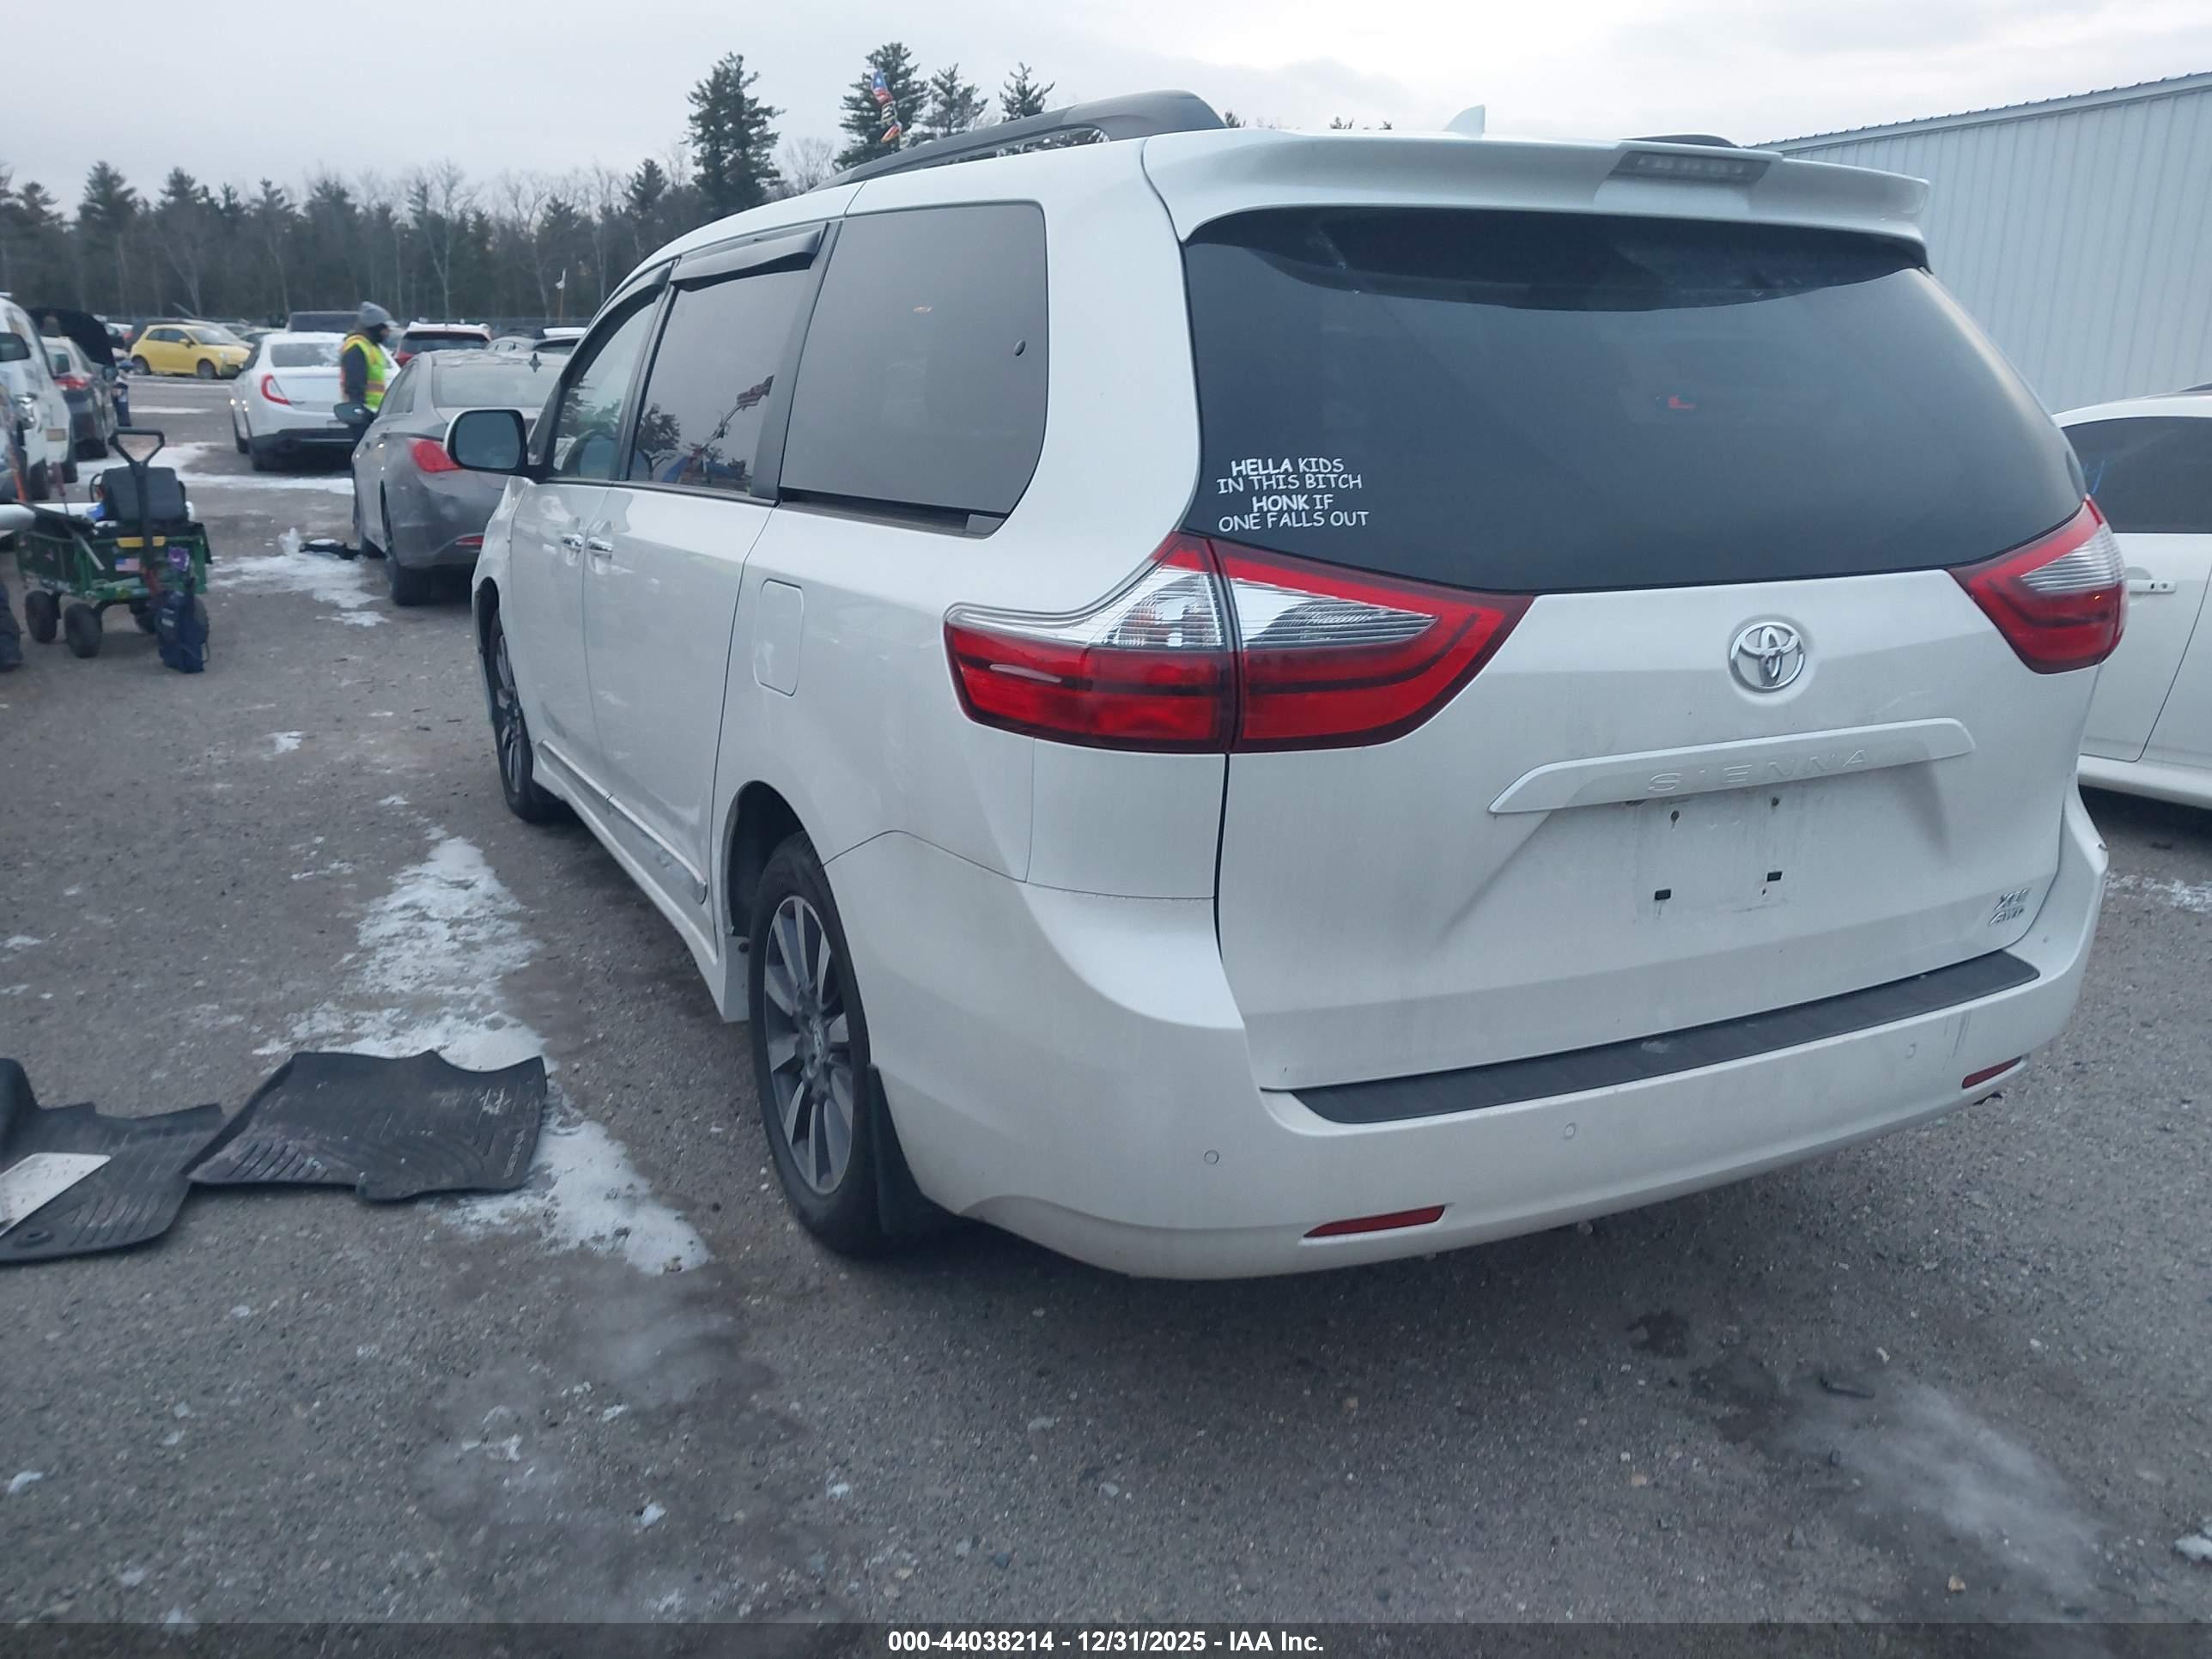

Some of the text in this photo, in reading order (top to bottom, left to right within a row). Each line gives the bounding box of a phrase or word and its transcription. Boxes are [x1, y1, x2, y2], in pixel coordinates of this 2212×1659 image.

[1230, 458, 1345, 477] HELLA KIDS
[1216, 473, 1363, 494] IN THIS BITCH
[1252, 494, 1334, 513] HONK IF
[1218, 510, 1370, 532] ONE FALLS OUT
